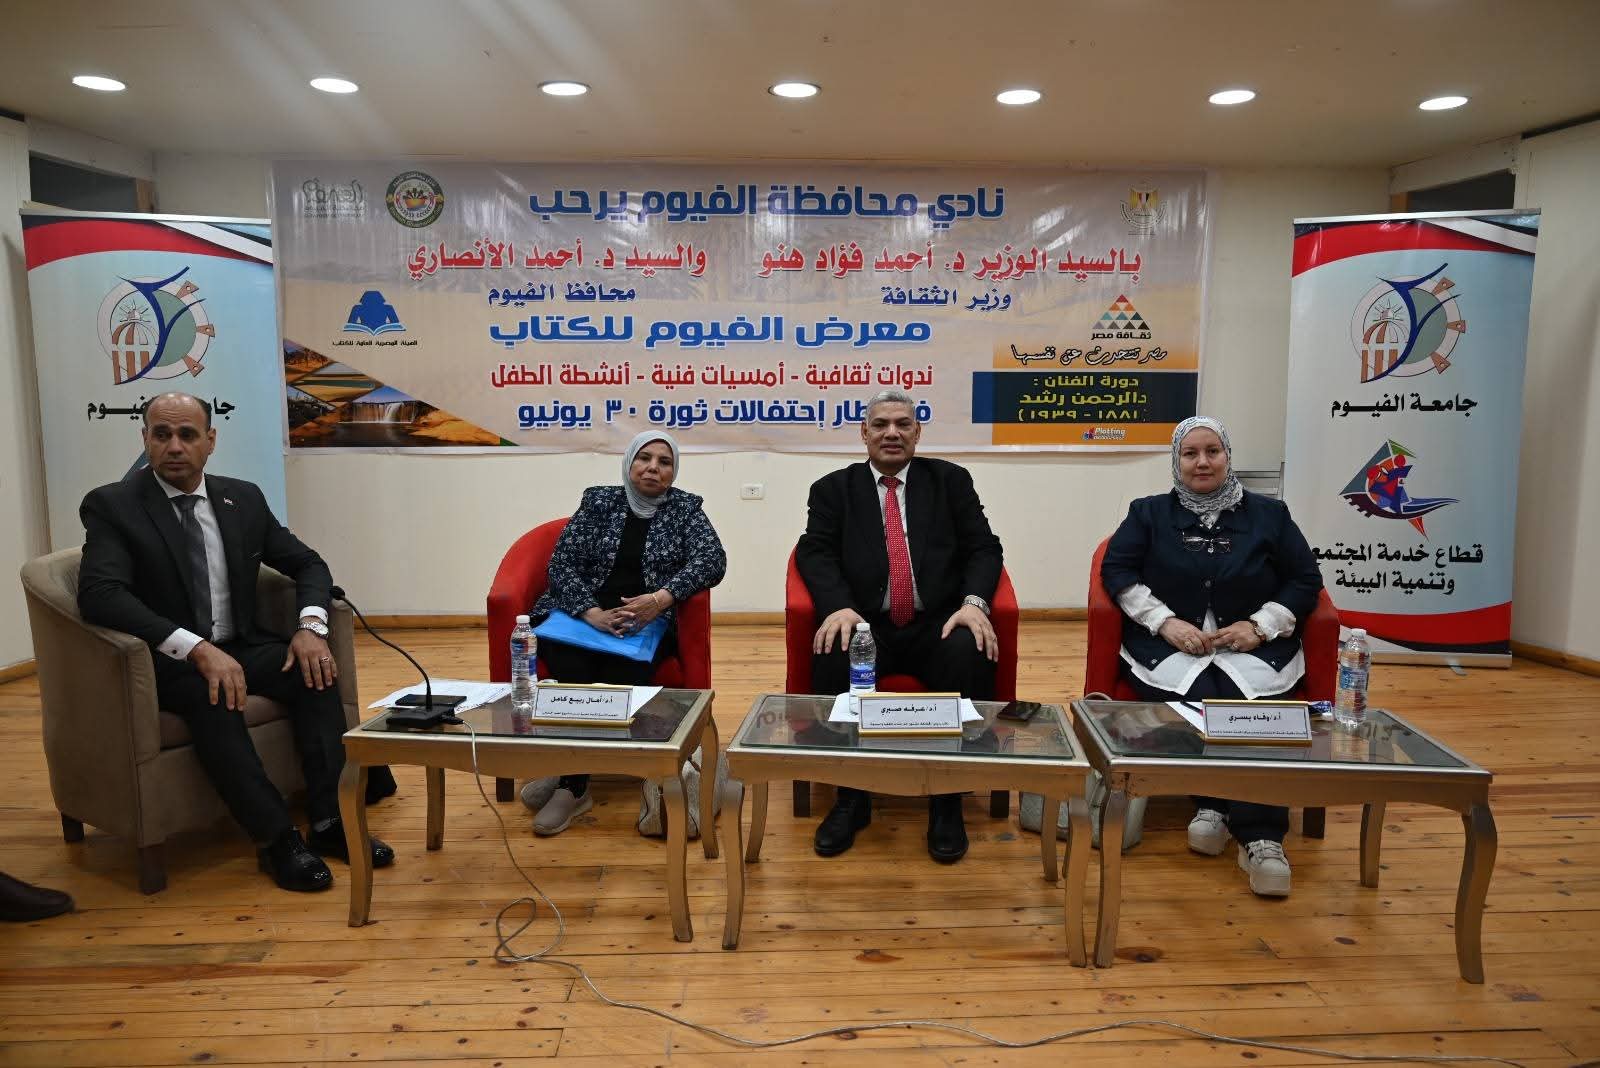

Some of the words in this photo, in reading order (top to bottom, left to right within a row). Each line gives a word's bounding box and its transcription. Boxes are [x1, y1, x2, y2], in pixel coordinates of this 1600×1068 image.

[530, 190, 628, 221] يرحب
[637, 184, 757, 223] الفيوم
[767, 184, 917, 216] محافظة
[928, 187, 1004, 228] نادي
[408, 237, 514, 280] الأنصاري
[525, 238, 583, 270] أحمد
[594, 247, 615, 268] د.
[625, 242, 707, 277] والسيد
[757, 243, 805, 278] هنو
[815, 241, 864, 278] فؤاد
[874, 240, 933, 272] أحمد
[945, 251, 965, 271] د.
[973, 244, 1047, 280] الوزير
[1058, 248, 1141, 281] بالسيد
[488, 282, 555, 307] الفيوم
[564, 283, 636, 302] محافظ
[881, 285, 957, 306] الثقافة
[965, 288, 1012, 311] وزير
[490, 315, 633, 346] للكتاب
[645, 316, 783, 348] الفيوم
[796, 316, 931, 347] معرض
[1091, 332, 1114, 341] مصر
[1117, 331, 1152, 341] ثقافة
[1010, 344, 1056, 366] نفسها
[1060, 346, 1082, 365] عن
[1085, 345, 1140, 366] تتحدث
[1141, 346, 1167, 363] مصر
[491, 364, 552, 388] الطفل
[559, 362, 630, 386] أنشطة
[651, 364, 695, 389] فنية
[701, 362, 784, 389] أمسيات
[805, 362, 872, 389] ثقافية
[877, 364, 933, 390] ندوات
[1044, 376, 1094, 387] الفنان
[1100, 375, 1139, 387] دورة
[87, 395, 147, 421] فيوم
[518, 401, 591, 427] يونيو
[606, 400, 636, 422] ٣٠
[649, 400, 708, 427] ثورة
[715, 400, 825, 428] إحتفالات
[832, 400, 868, 426] طار
[915, 400, 931, 421] ف
[1331, 392, 1405, 418] الفيوم
[1410, 392, 1478, 418] جامعة
[1377, 543, 1430, 562] خدمة
[1435, 543, 1484, 569] قطاع
[1335, 569, 1387, 594] البيئة
[1392, 570, 1455, 595] وتنمية
[568, 696, 585, 705] ربيع
[880, 705, 902, 716] صبري
